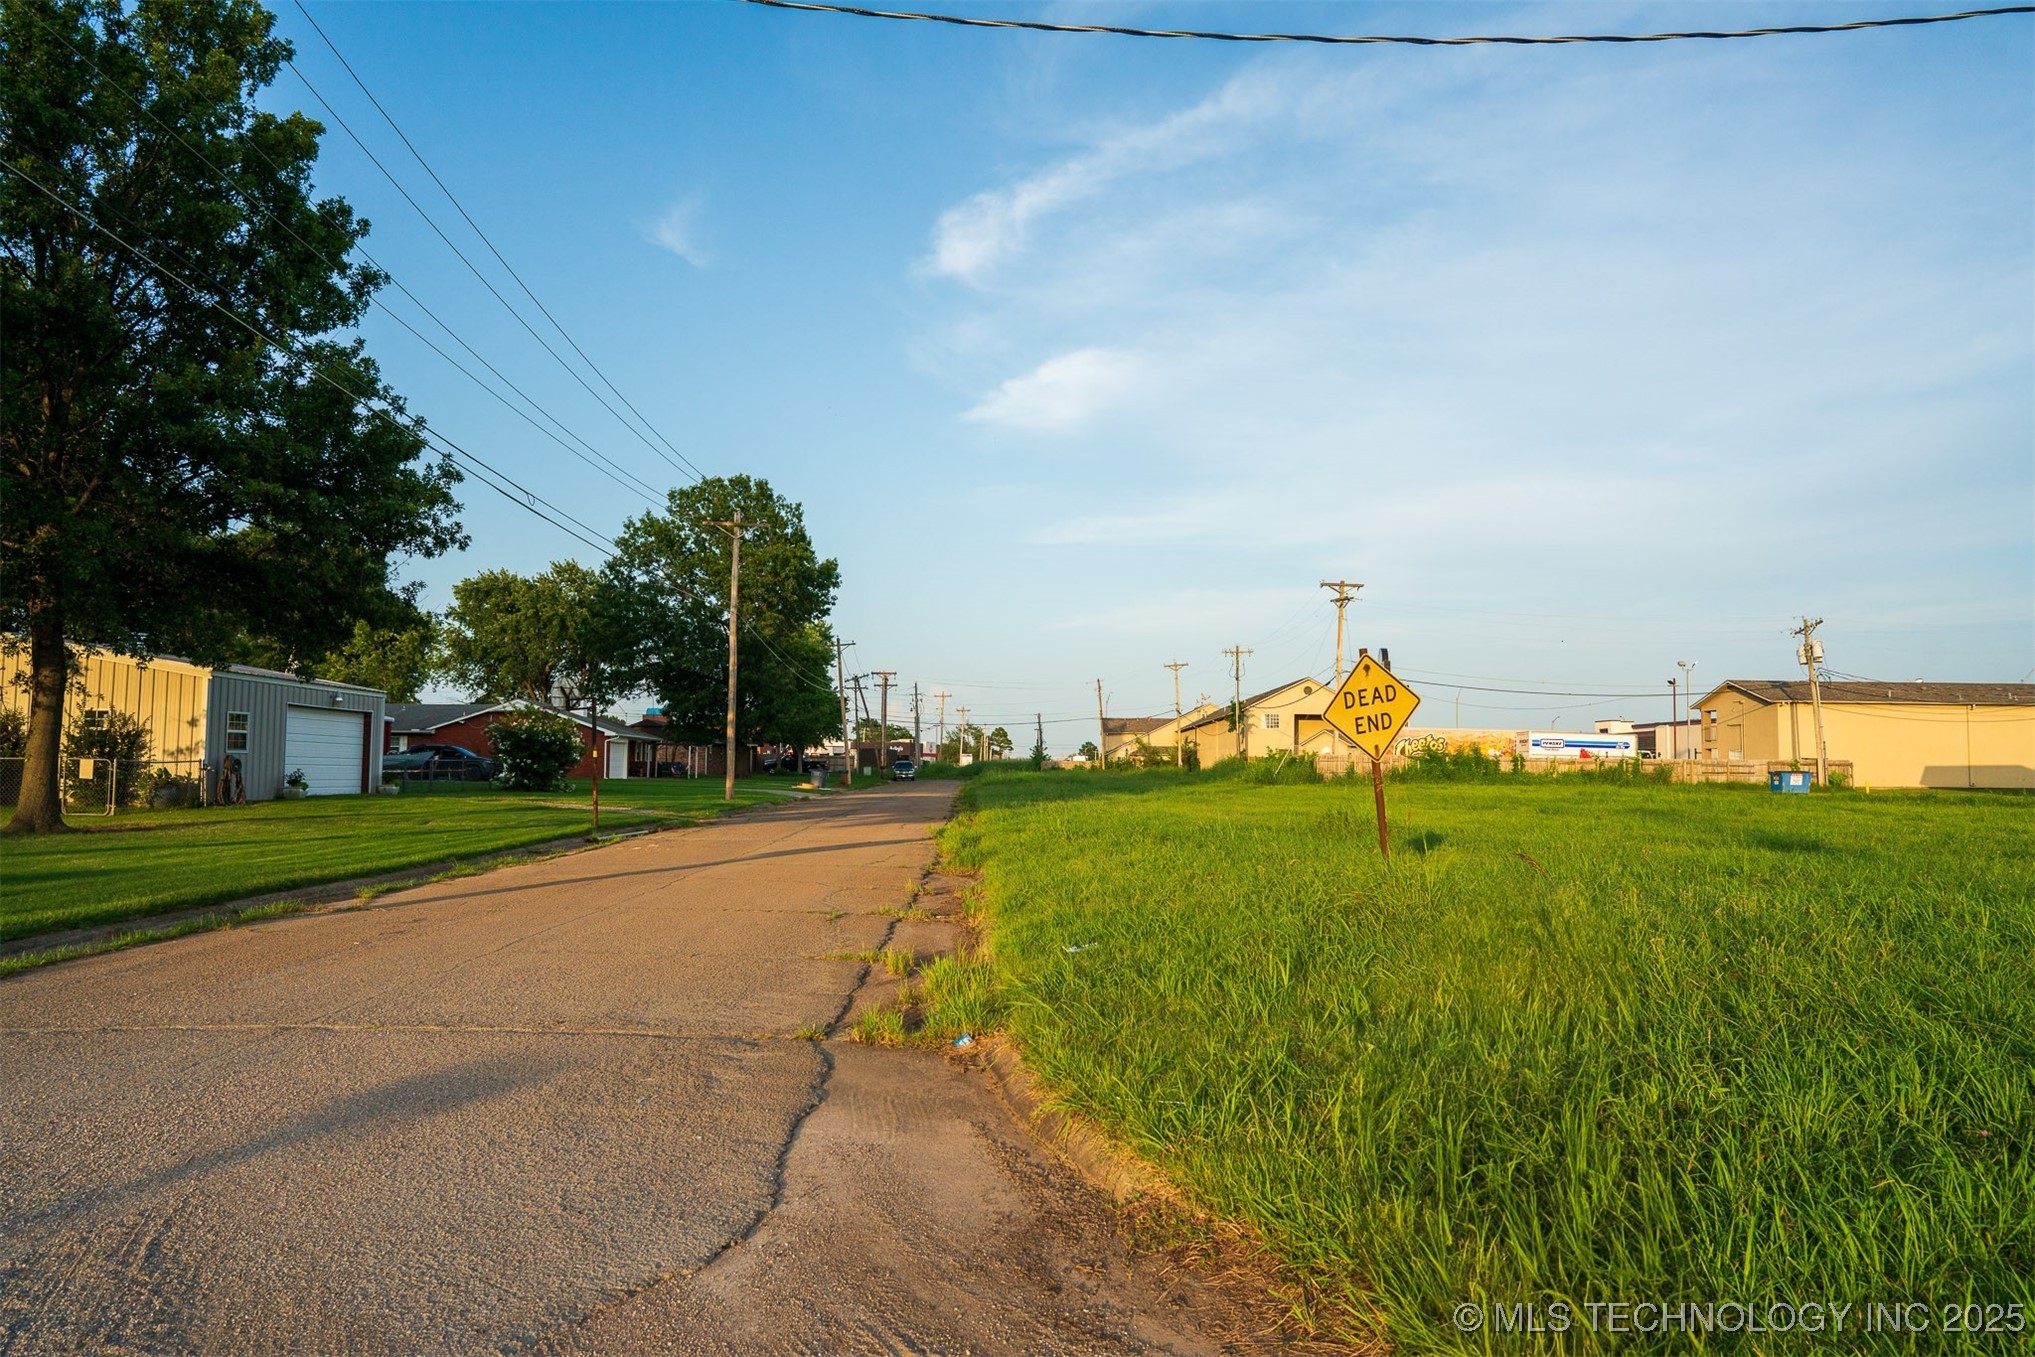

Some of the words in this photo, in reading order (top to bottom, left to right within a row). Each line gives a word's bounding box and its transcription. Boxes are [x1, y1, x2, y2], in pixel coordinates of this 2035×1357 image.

[1343, 684, 1397, 709] DEAD
[1354, 712, 1392, 735] END
[1394, 733, 1446, 755] Cheetos
